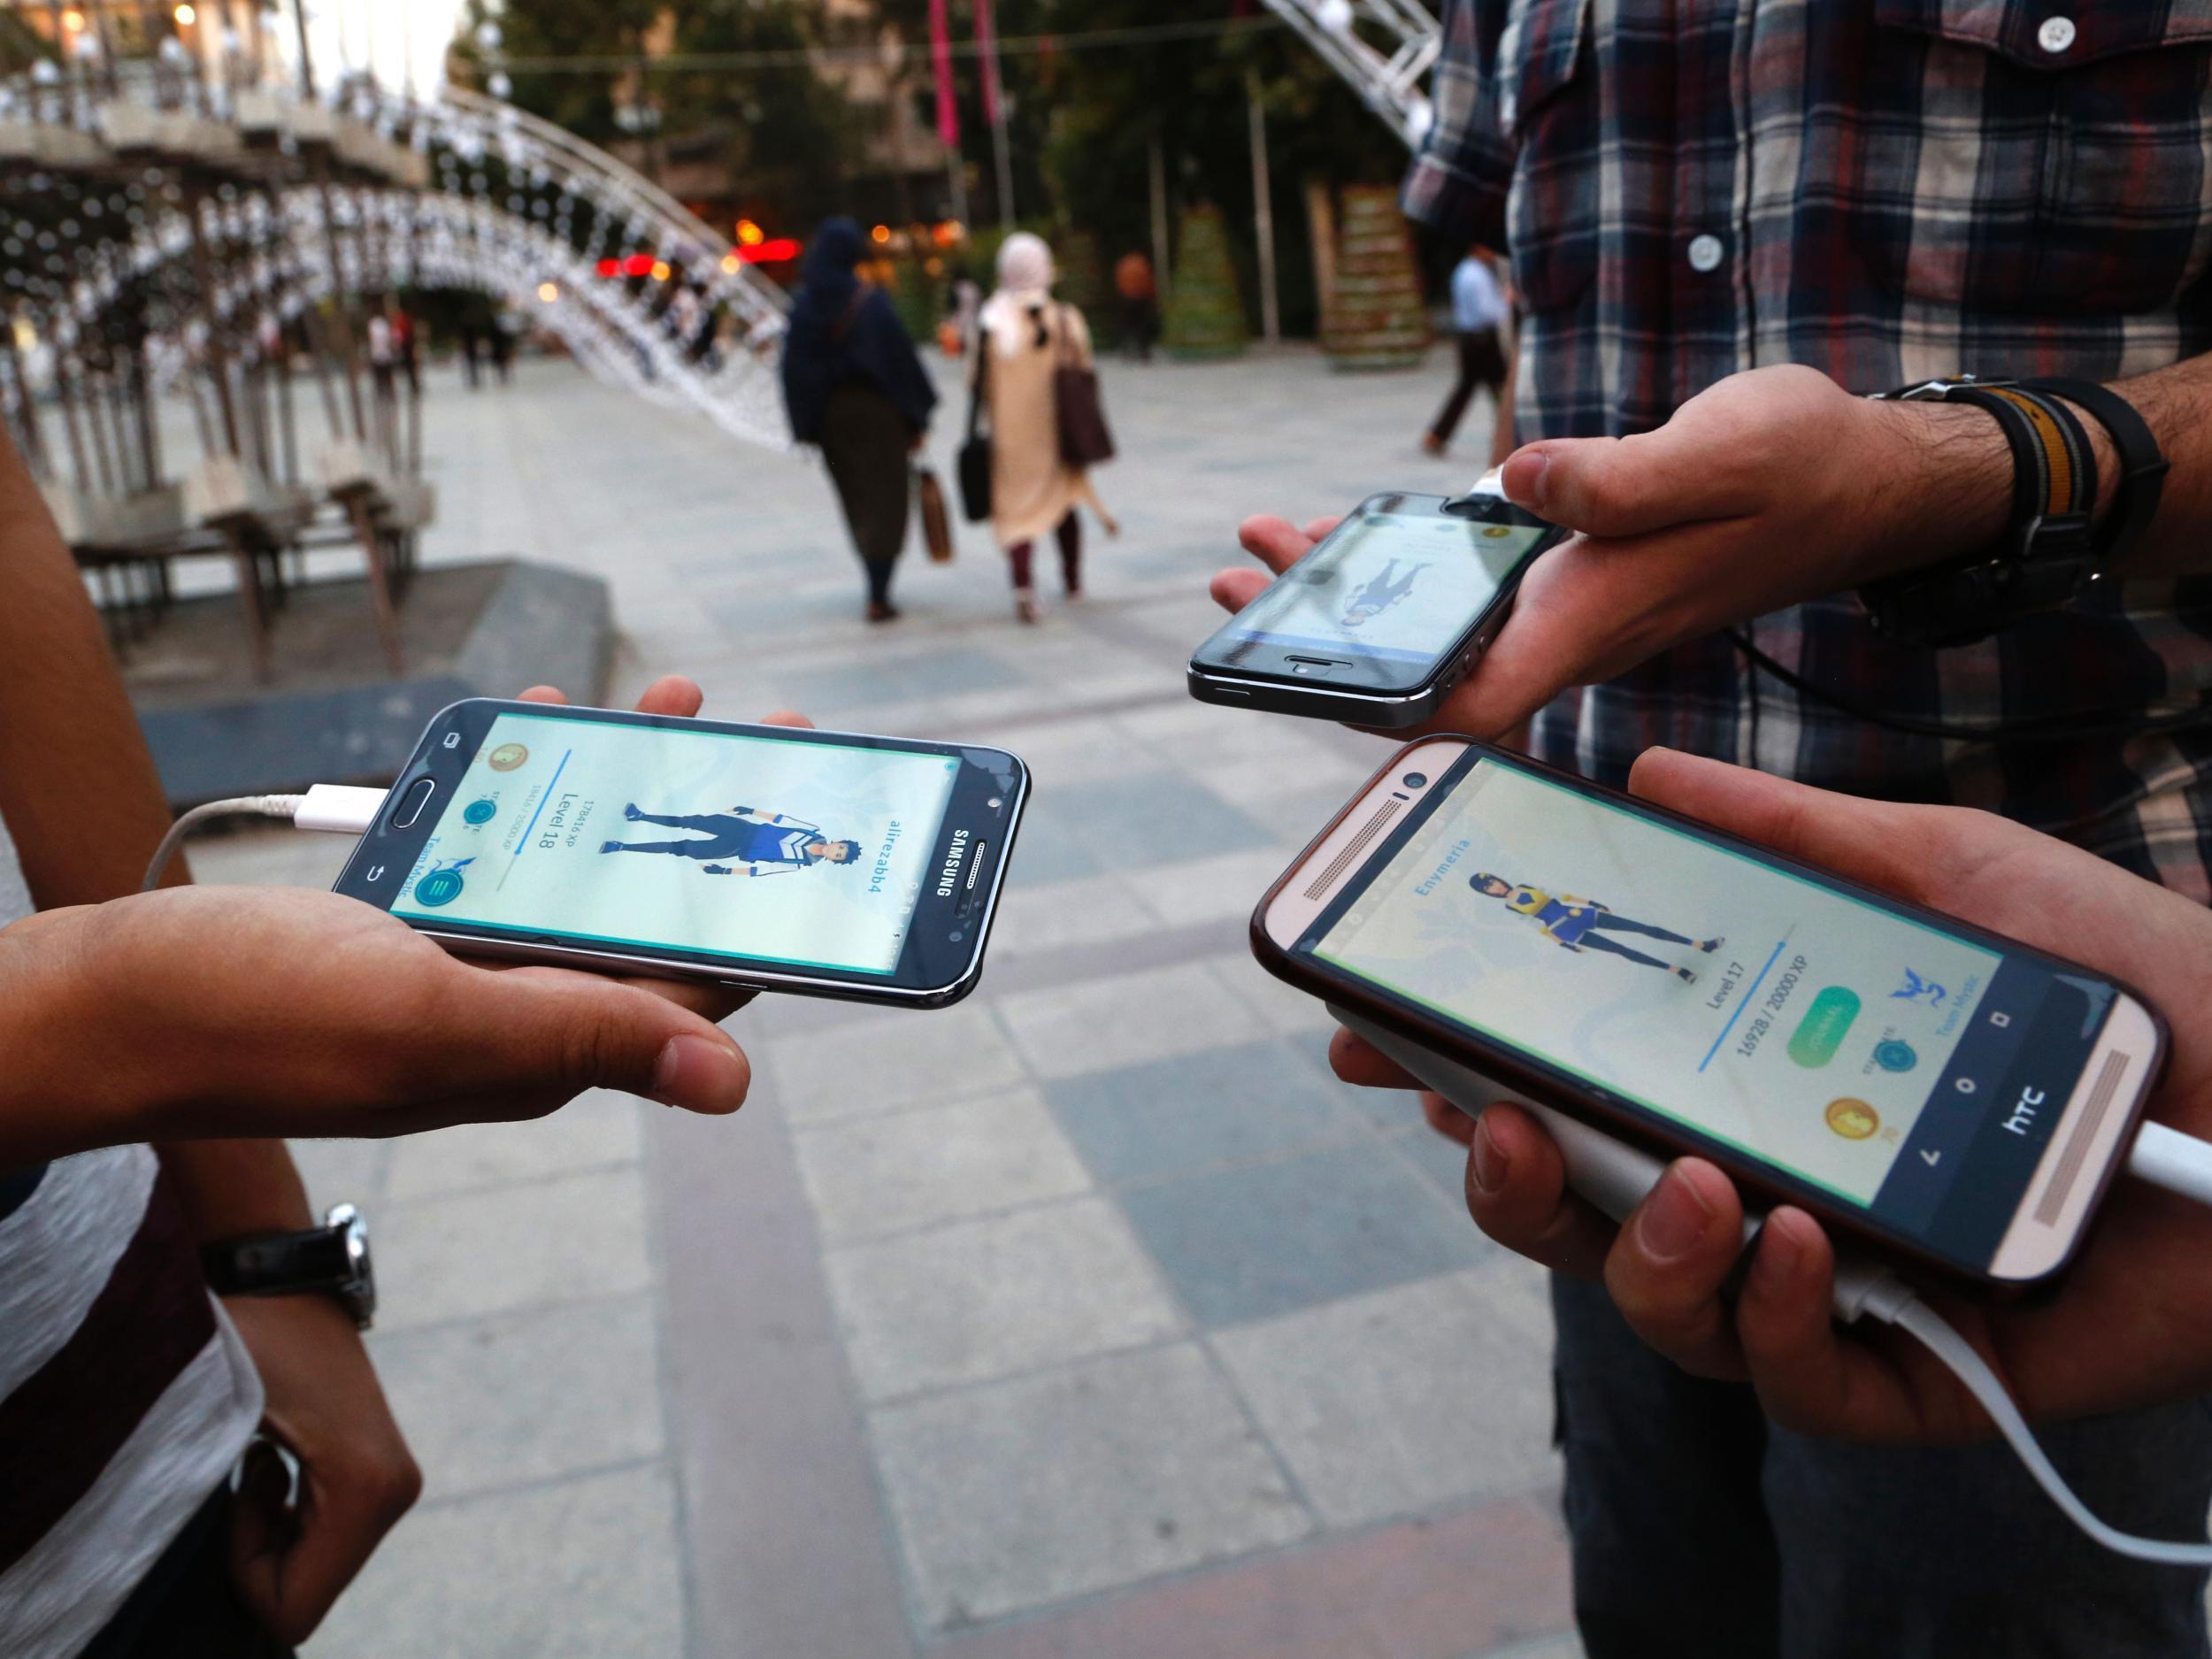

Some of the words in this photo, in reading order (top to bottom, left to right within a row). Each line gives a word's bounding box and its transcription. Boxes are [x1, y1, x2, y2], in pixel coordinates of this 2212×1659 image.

[549, 793, 579, 828] Level
[570, 800, 595, 836] 178416
[419, 836, 441, 867] Team
[539, 831, 559, 849] 18
[868, 820, 902, 893] alirezabb4
[937, 829, 969, 896] SAMSUNG
[1415, 839, 1471, 896] Enymeria
[1706, 976, 1736, 1010] Level
[1727, 961, 1746, 979] 17
[1736, 1018, 1770, 1058] 16928
[1766, 972, 1799, 1011] 20000
[1789, 954, 1809, 976] XP
